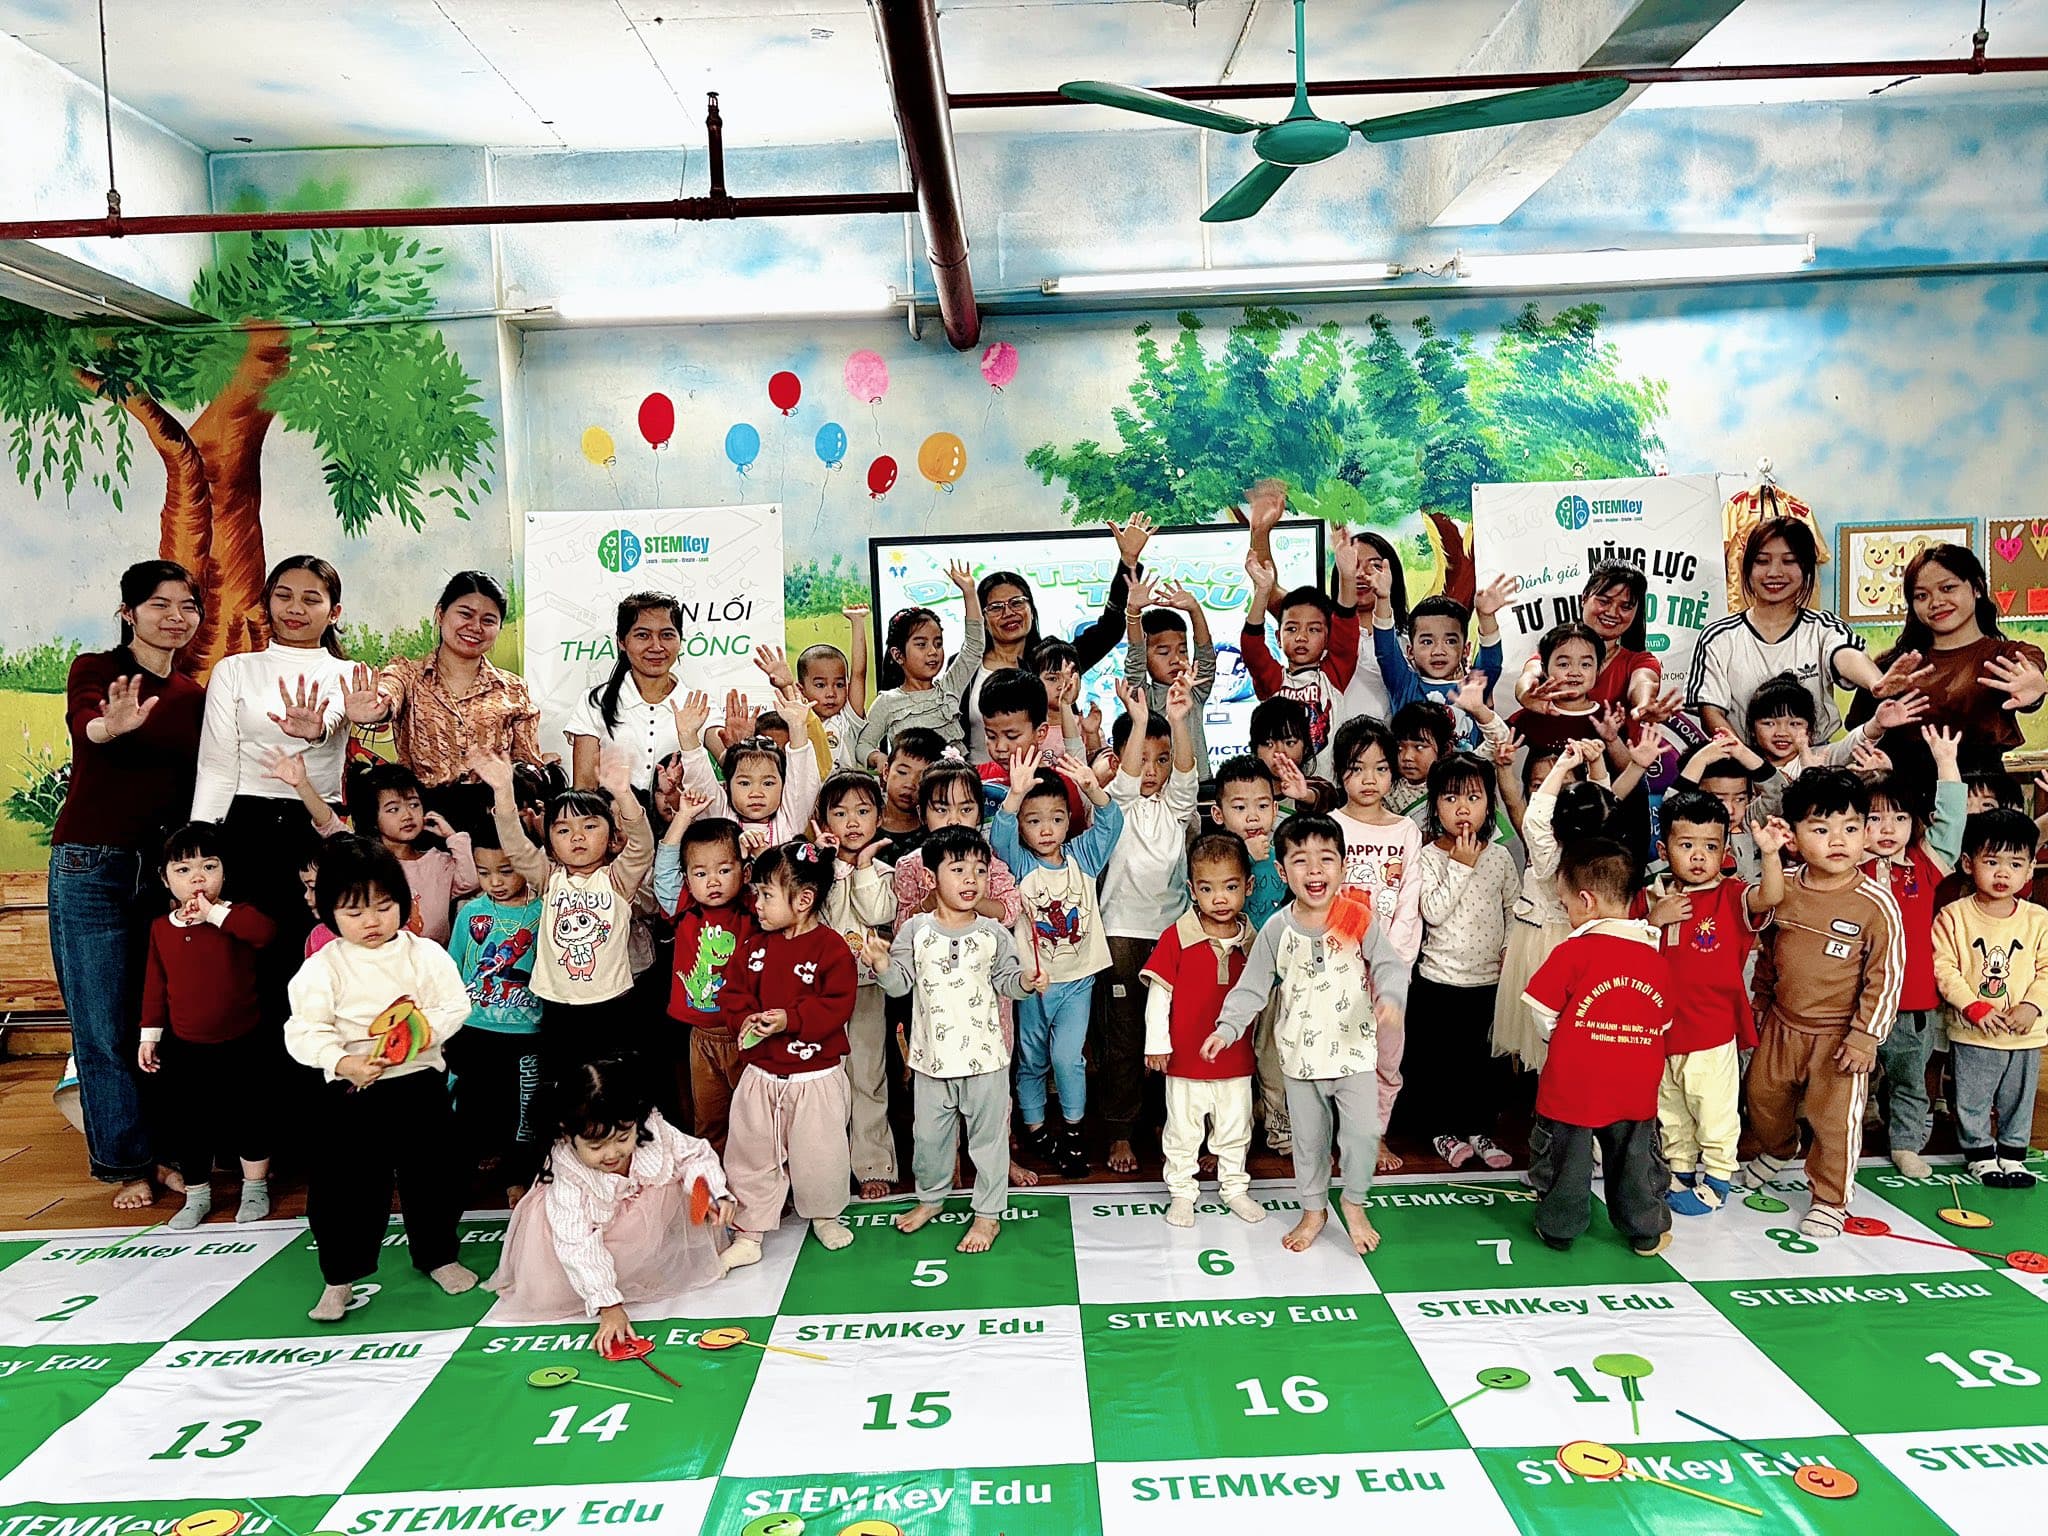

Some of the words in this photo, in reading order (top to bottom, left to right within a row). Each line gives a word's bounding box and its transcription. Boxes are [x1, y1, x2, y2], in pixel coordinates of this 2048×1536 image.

[1592, 499, 1642, 514] STEMKey
[644, 535, 710, 554] STEMKey
[1557, 563, 1580, 584] giá
[1653, 549, 1697, 584] LỰC
[707, 594, 752, 622] LỐI
[1512, 597, 1545, 634] TƯ
[1552, 593, 1583, 625] DU
[1667, 591, 1709, 630] TRẺ
[560, 635, 616, 661] THÀ
[680, 632, 750, 658] ÔNG
[1347, 844, 1383, 857] APPY
[1832, 943, 1844, 956] R
[1591, 980, 1613, 998] NON
[1591, 1032, 1616, 1043] Hotline:
[1001, 1207, 1039, 1221] du
[1092, 1200, 1232, 1218] STEMey
[1265, 1199, 1302, 1212] du
[42, 1245, 191, 1262] STEMKey
[194, 1242, 258, 1256] Edu
[1476, 1238, 1513, 1265] 7
[1765, 1227, 1819, 1254] 8
[910, 1259, 949, 1288] 5
[1198, 1249, 1235, 1276] 6
[345, 1283, 382, 1311] 3
[1417, 1297, 1589, 1317] STEMKey
[1597, 1294, 1675, 1311] Edu
[1730, 1285, 1909, 1307] STEMKey
[1910, 1281, 1992, 1299] Edu
[35, 1295, 98, 1321] 2
[1107, 1308, 1276, 1329] STEMKey
[1287, 1305, 1358, 1323] Edu
[796, 1321, 965, 1341] STEMKey
[979, 1318, 1044, 1335] Edu
[34, 1354, 111, 1373] Edu
[166, 1346, 344, 1368] STEMKey
[349, 1342, 423, 1361] Edu
[1925, 1349, 2041, 1389] 18
[1235, 1375, 1329, 1416] 16
[533, 1402, 631, 1445] 14
[863, 1390, 952, 1430] 15
[148, 1419, 263, 1460] 13
[1516, 1454, 1735, 1485] STMKey
[1906, 1442, 2048, 1471] STEM
[1131, 1472, 1341, 1501] STEMKey
[1355, 1467, 1446, 1493] Edu
[741, 1485, 955, 1517] STEMKey
[969, 1479, 1052, 1506] Edu
[347, 1503, 567, 1535] STEMKey
[577, 1498, 665, 1526] Edu
